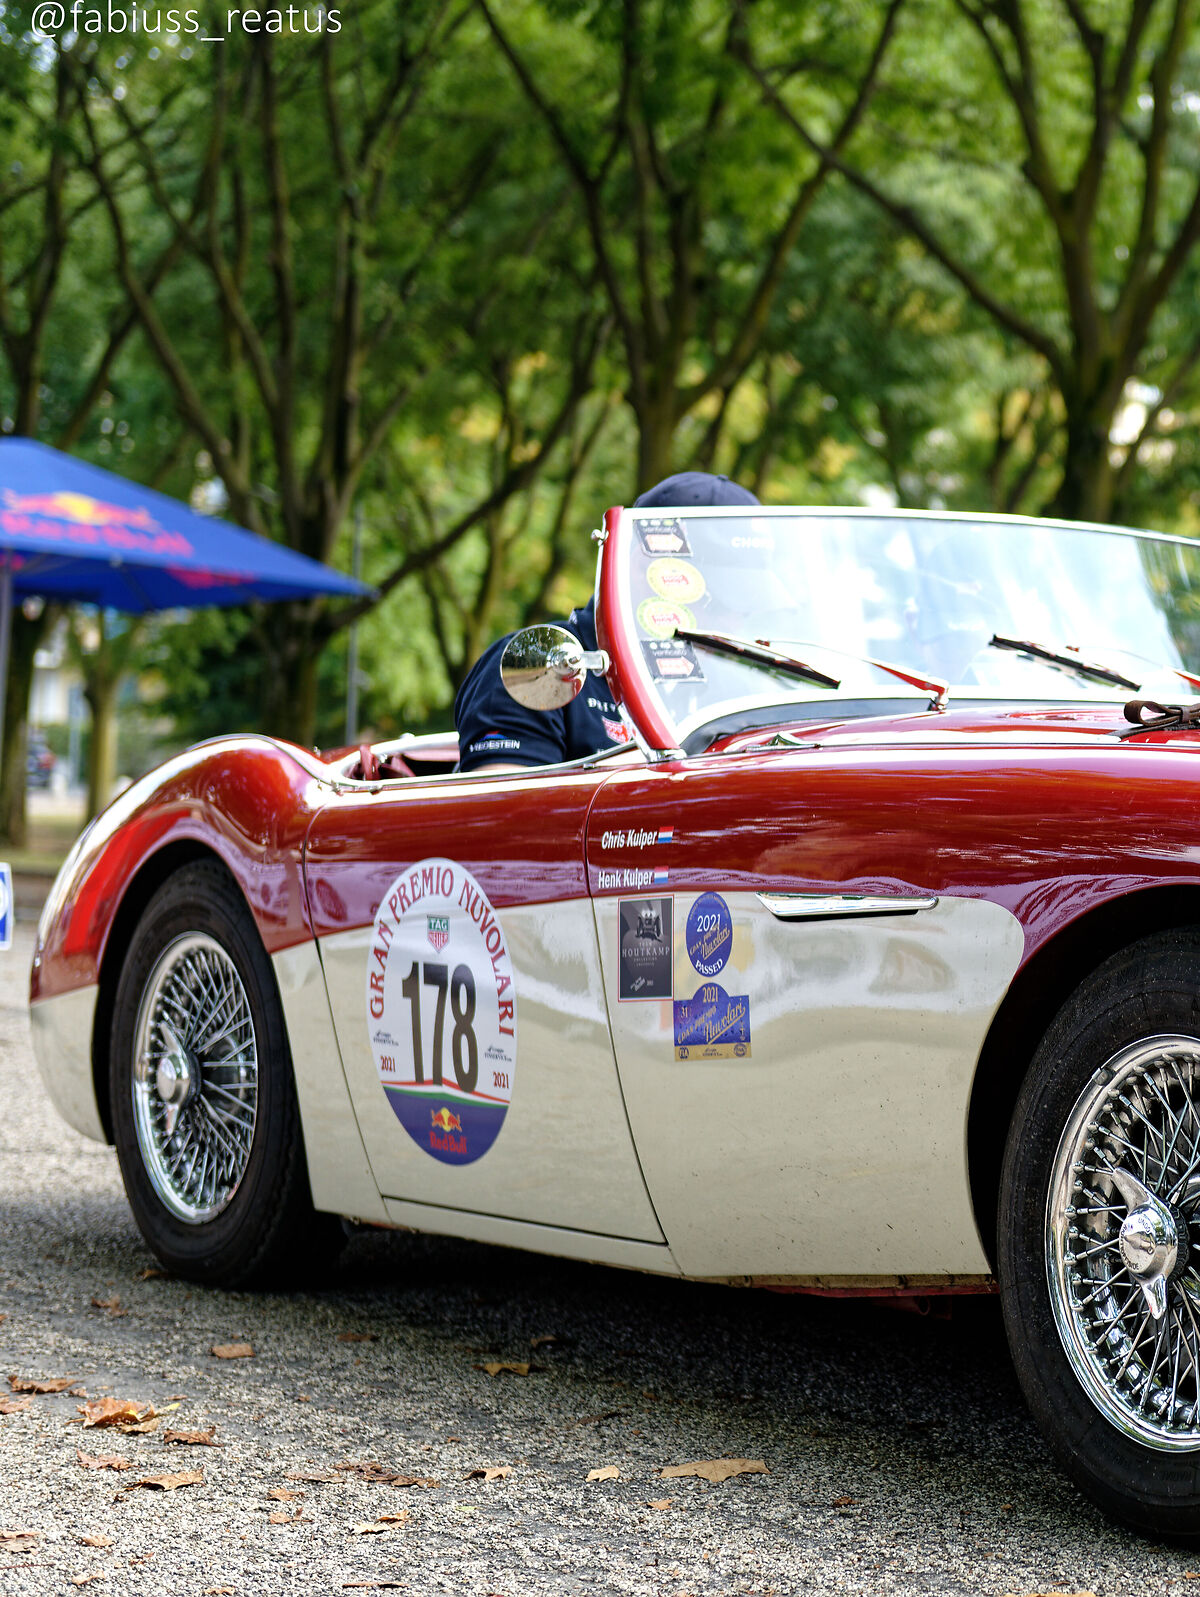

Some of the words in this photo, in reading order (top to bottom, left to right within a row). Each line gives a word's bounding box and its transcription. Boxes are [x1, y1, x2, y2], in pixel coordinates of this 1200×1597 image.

[601, 829, 626, 850] Chris
[626, 827, 658, 850] Kuiper
[598, 869, 622, 889] Henk
[623, 866, 653, 890] Kuiper
[430, 919, 448, 931] TAG
[696, 913, 721, 933] 2021
[370, 919, 394, 1020] GRAN
[387, 866, 455, 924] PREMIO
[458, 878, 515, 1038] NUVOLARI
[622, 945, 670, 958] HOUTKAMP
[695, 957, 723, 975] PASSED
[702, 986, 719, 1003] 2021
[401, 960, 479, 1094] 178
[703, 997, 746, 1045] Nuvolari
[380, 1055, 396, 1073] 2021
[492, 1071, 510, 1089] 2021
[430, 1130, 449, 1153] Red
[449, 1134, 468, 1156] Bull
